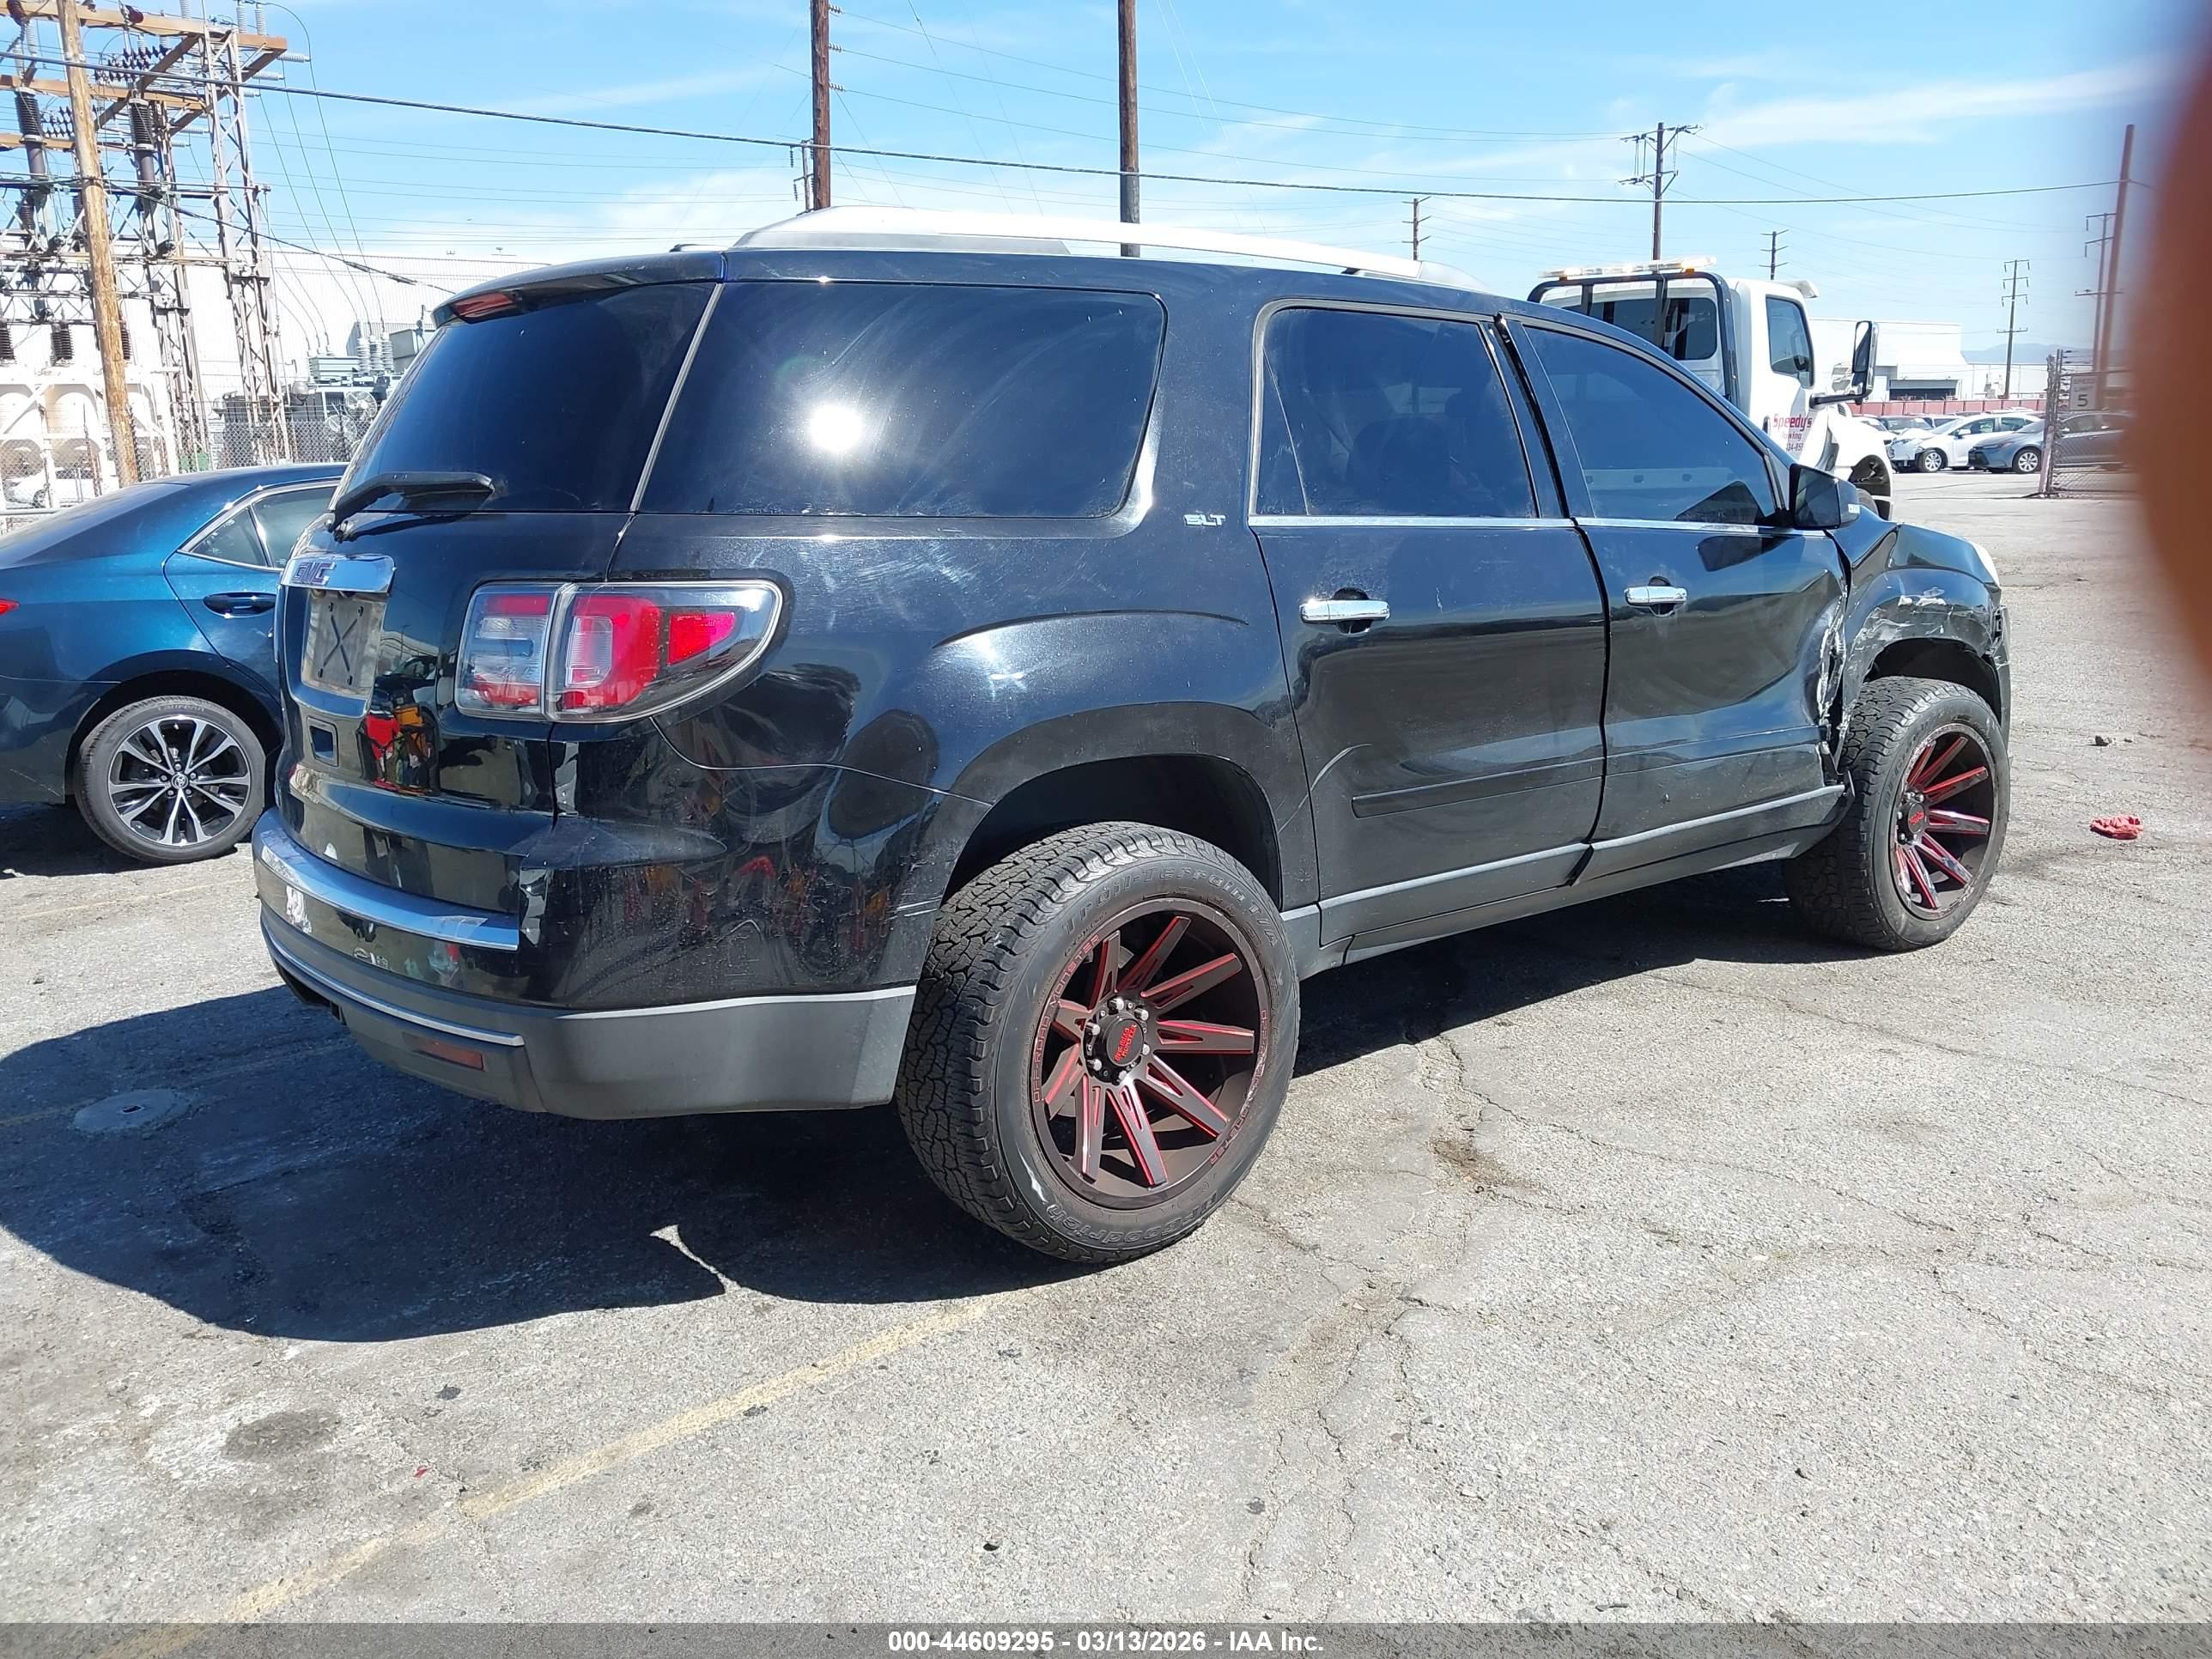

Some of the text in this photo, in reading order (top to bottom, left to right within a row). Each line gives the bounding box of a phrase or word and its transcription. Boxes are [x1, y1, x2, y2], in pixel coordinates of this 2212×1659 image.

[2077, 393, 2088, 407] 5
[1183, 514, 1226, 526] SLT
[291, 561, 337, 586] GMC
[1061, 866, 1246, 936] Trail-Terrain
[1248, 903, 1279, 948] T/A
[1032, 1015, 1051, 1103] OFF-ROAD
[1049, 933, 1100, 1007] MONSTER
